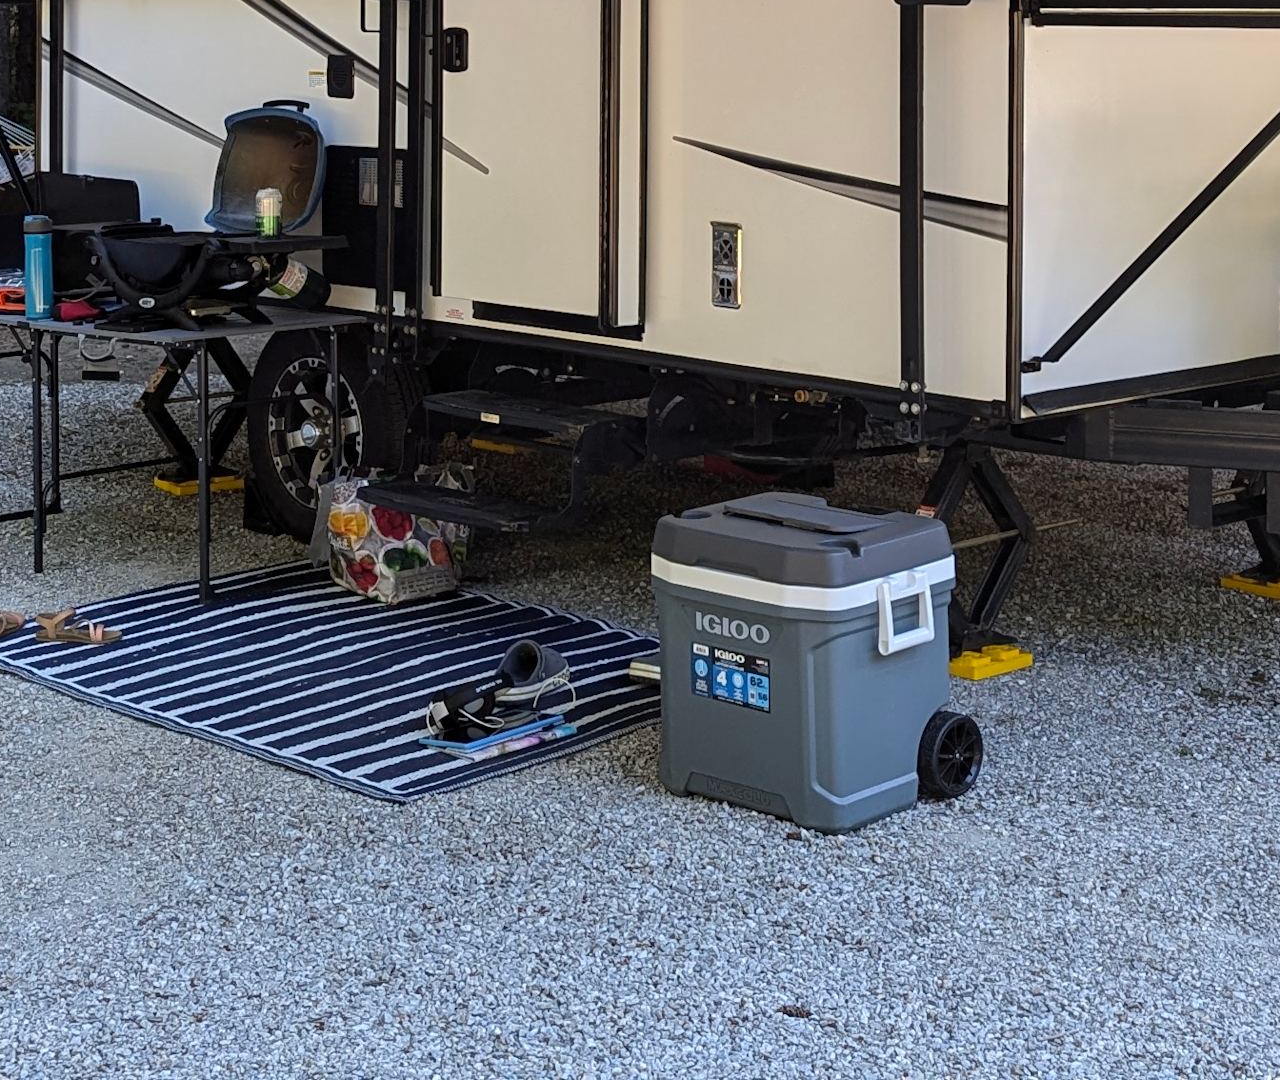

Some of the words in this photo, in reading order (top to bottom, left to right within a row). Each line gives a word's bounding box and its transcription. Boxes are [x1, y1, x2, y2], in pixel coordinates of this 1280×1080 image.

[695, 611, 770, 644] IGLOO
[714, 648, 745, 664] IGLOO
[716, 671, 728, 686] 4
